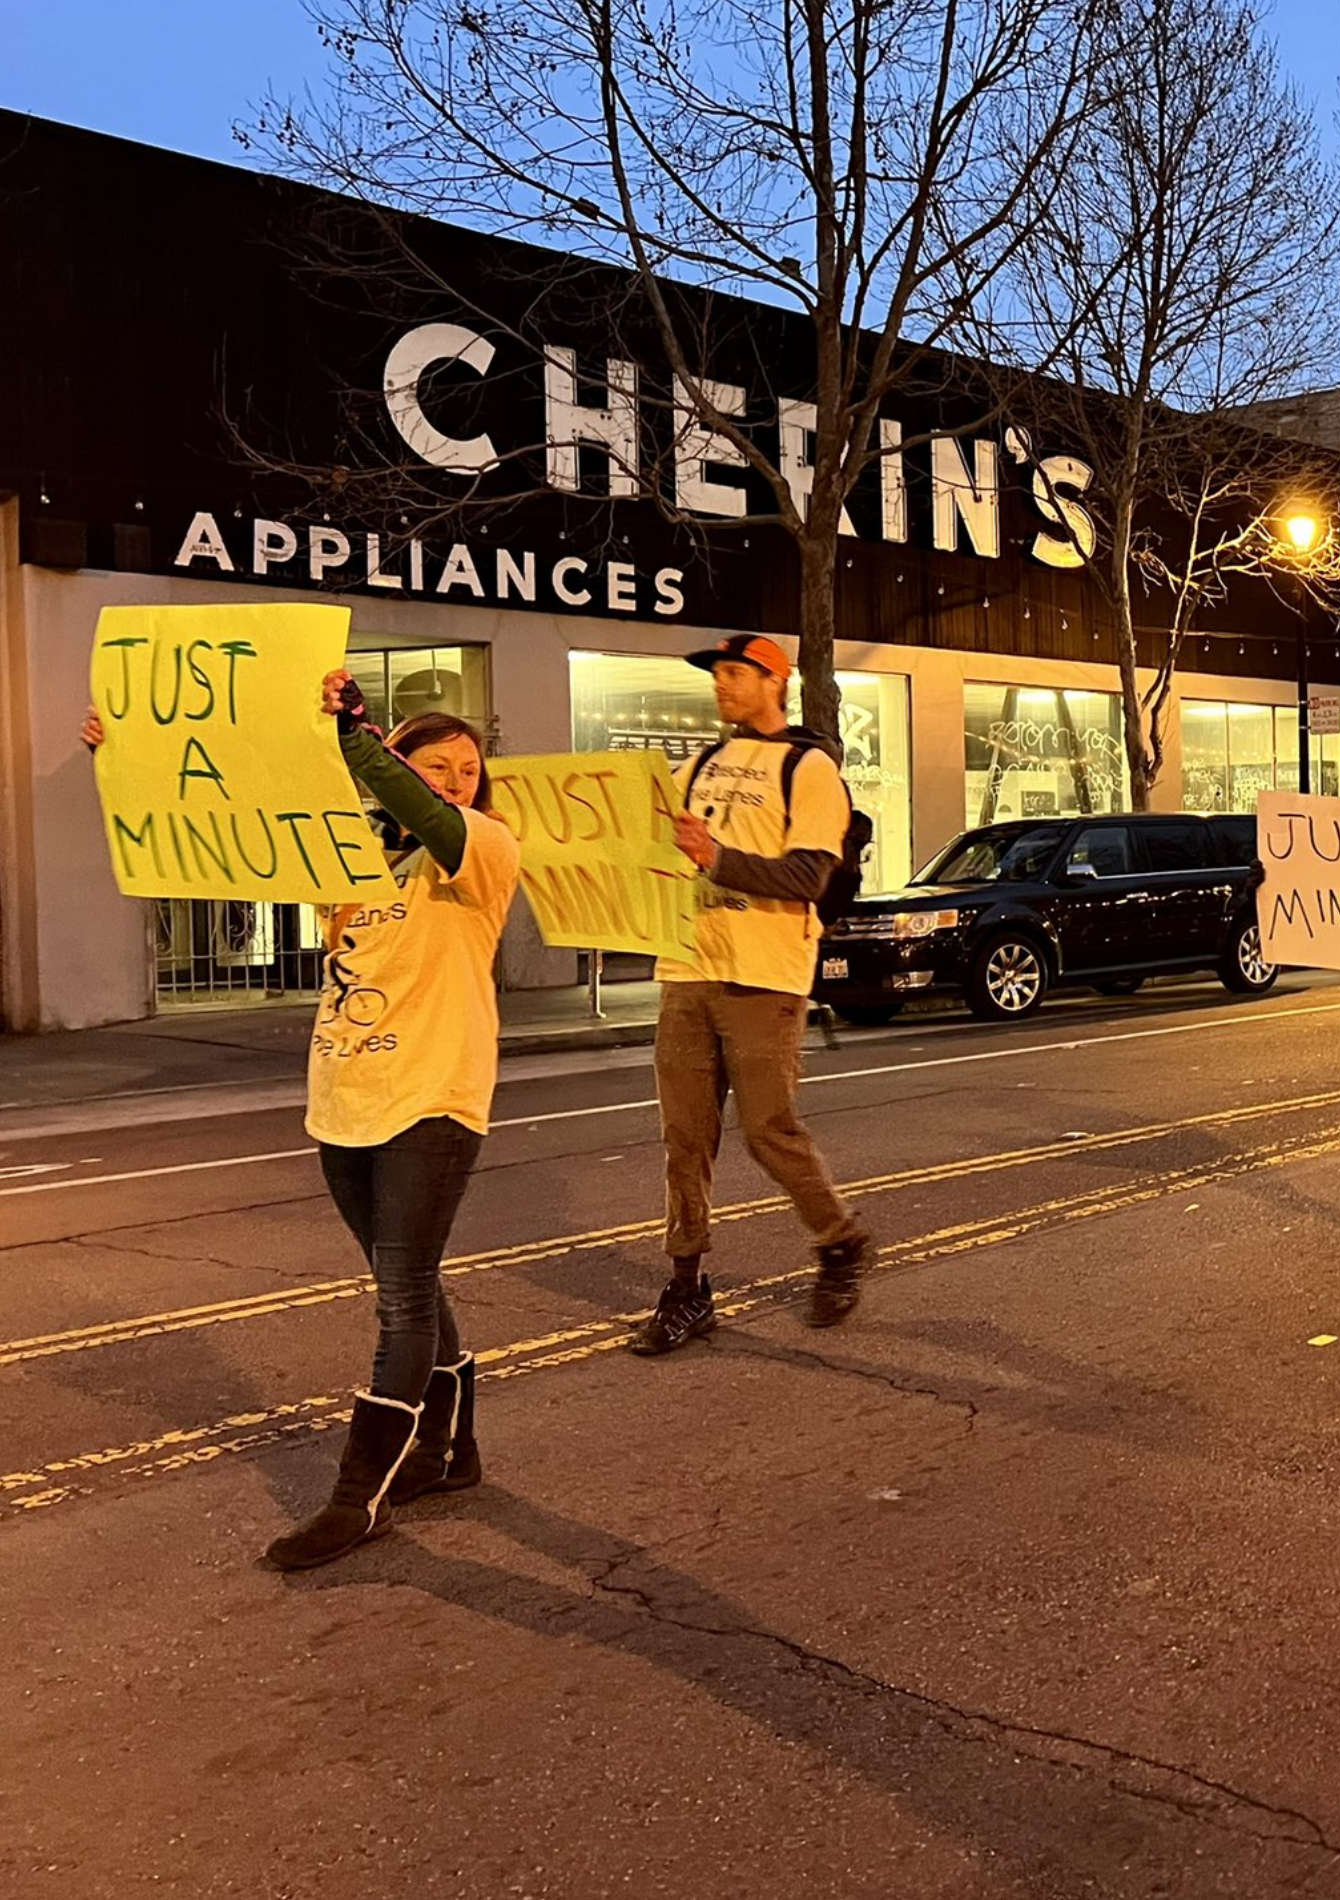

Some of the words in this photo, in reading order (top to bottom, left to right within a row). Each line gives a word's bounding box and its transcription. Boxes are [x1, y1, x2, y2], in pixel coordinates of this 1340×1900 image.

[174, 512, 685, 616] APPLIANCES
[101, 637, 258, 725] JUST
[178, 736, 231, 801] A
[492, 769, 620, 844] JUST
[112, 808, 383, 889] MINUTE
